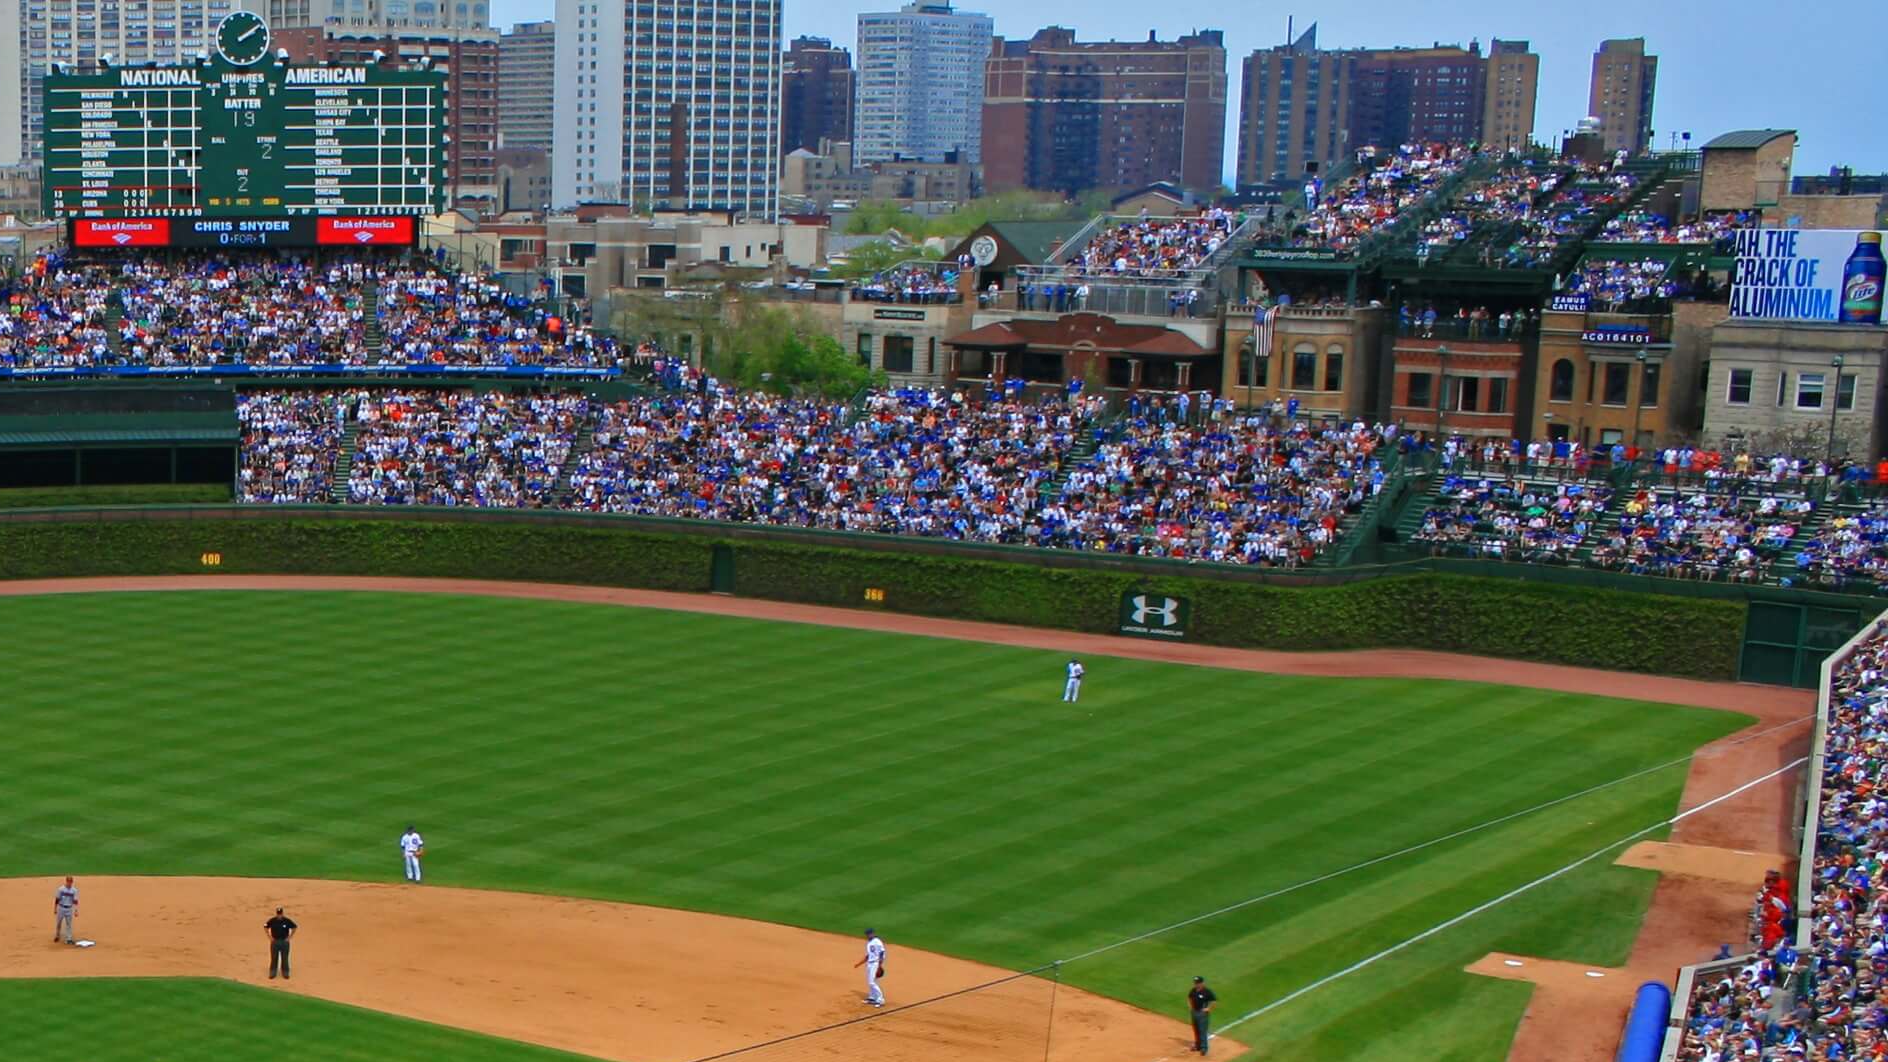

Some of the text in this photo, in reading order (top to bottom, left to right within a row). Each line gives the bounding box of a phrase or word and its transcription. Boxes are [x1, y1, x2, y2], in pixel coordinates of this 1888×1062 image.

[121, 69, 201, 86] NATIONAL
[222, 73, 264, 83] UMPIRES
[285, 68, 366, 84] AMERICAN
[224, 98, 261, 109] BATTER
[234, 111, 255, 127] 19
[262, 144, 272, 159] 2
[238, 177, 248, 192] 2
[92, 222, 153, 231] Bank of America
[194, 221, 290, 231] CHRIS SNYDER
[334, 220, 395, 228] Bank of America
[220, 233, 229, 244] 0
[259, 233, 266, 244] 1
[1737, 231, 1800, 258] AH, THE
[1734, 258, 1819, 286] CRACK OF
[1729, 288, 1835, 319] ALUMINUM.
[201, 553, 220, 565] 400
